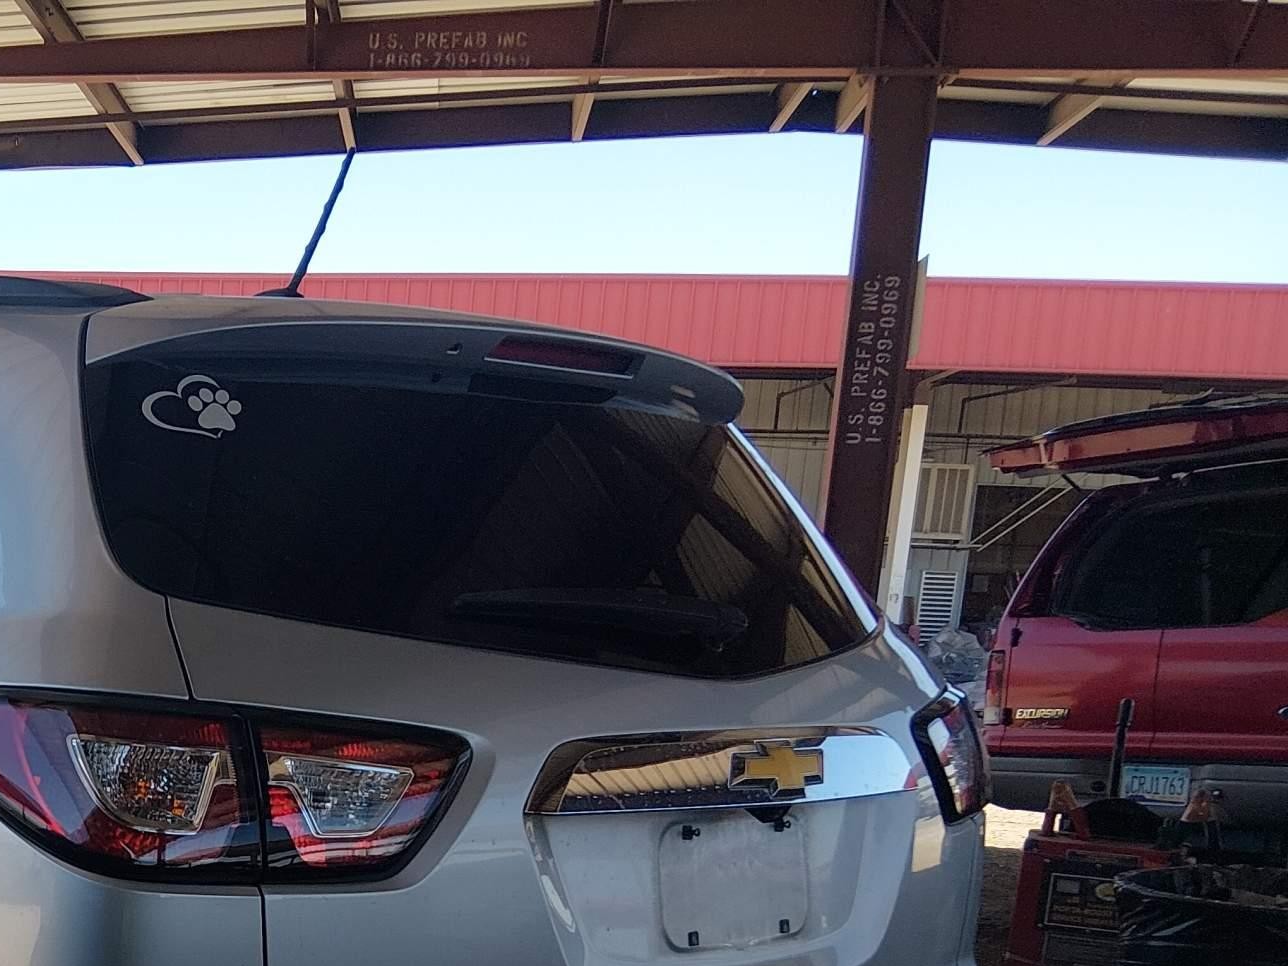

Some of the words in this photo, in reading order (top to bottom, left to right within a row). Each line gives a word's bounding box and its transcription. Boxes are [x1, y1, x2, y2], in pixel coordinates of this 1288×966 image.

[415, 31, 487, 49] PREFAB
[497, 31, 529, 48] INC
[369, 51, 531, 68] 1-866-799-0969
[851, 322, 875, 396] PREFAB
[865, 275, 901, 443] 1-866-799-0969
[846, 407, 866, 445] U.S.
